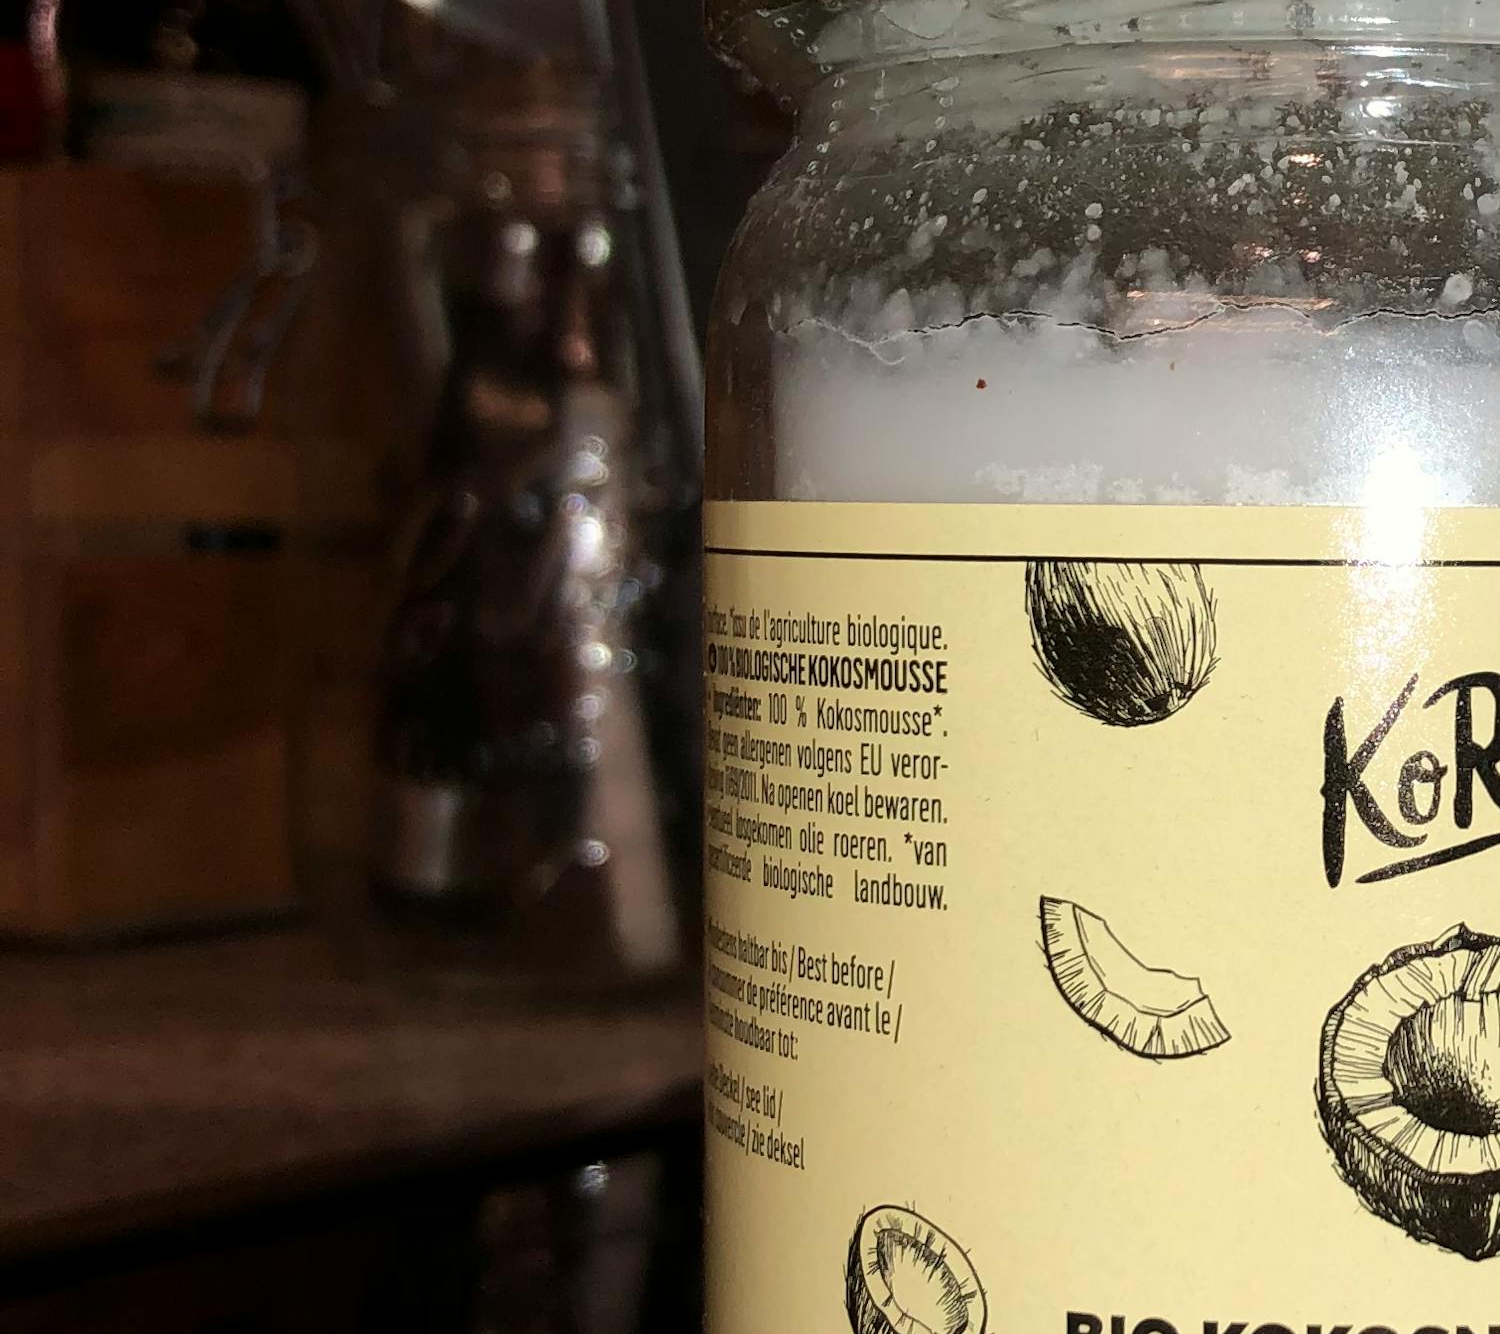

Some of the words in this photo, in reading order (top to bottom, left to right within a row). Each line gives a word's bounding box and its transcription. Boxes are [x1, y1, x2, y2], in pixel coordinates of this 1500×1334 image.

[749, 608, 761, 640] de
[763, 609, 840, 649] l'agriculture
[847, 614, 948, 656] biologique.
[736, 648, 806, 686] BIOLOGISCHE
[808, 654, 948, 694] KOKOSMOUSSE
[768, 693, 787, 725] 100
[796, 695, 807, 728] %
[740, 730, 792, 769] allergenen
[797, 739, 852, 778] volgens
[861, 743, 882, 776] EU
[891, 753, 949, 780] veror-
[761, 773, 775, 806] Na
[778, 780, 823, 816] openen
[828, 783, 860, 817] koel
[865, 785, 948, 824] bewaren.
[736, 806, 792, 850] losgekomen
[800, 822, 824, 855] olie
[833, 833, 892, 863] roeren.
[762, 854, 833, 900] biologische
[854, 869, 948, 911] landbouw.
[738, 930, 769, 970] haltbar
[771, 940, 788, 975] bis
[798, 946, 828, 984] Best
[831, 952, 884, 991] before
[747, 974, 757, 1007] de
[759, 981, 823, 1025] préférence
[826, 1001, 871, 1033] avant
[875, 1001, 890, 1036] le
[735, 1009, 776, 1054] houdbaar
[778, 1028, 798, 1060] tot:
[746, 1085, 761, 1113] see
[763, 1085, 776, 1119] lid
[751, 1124, 765, 1157] zie
[767, 1127, 805, 1170] deksel
